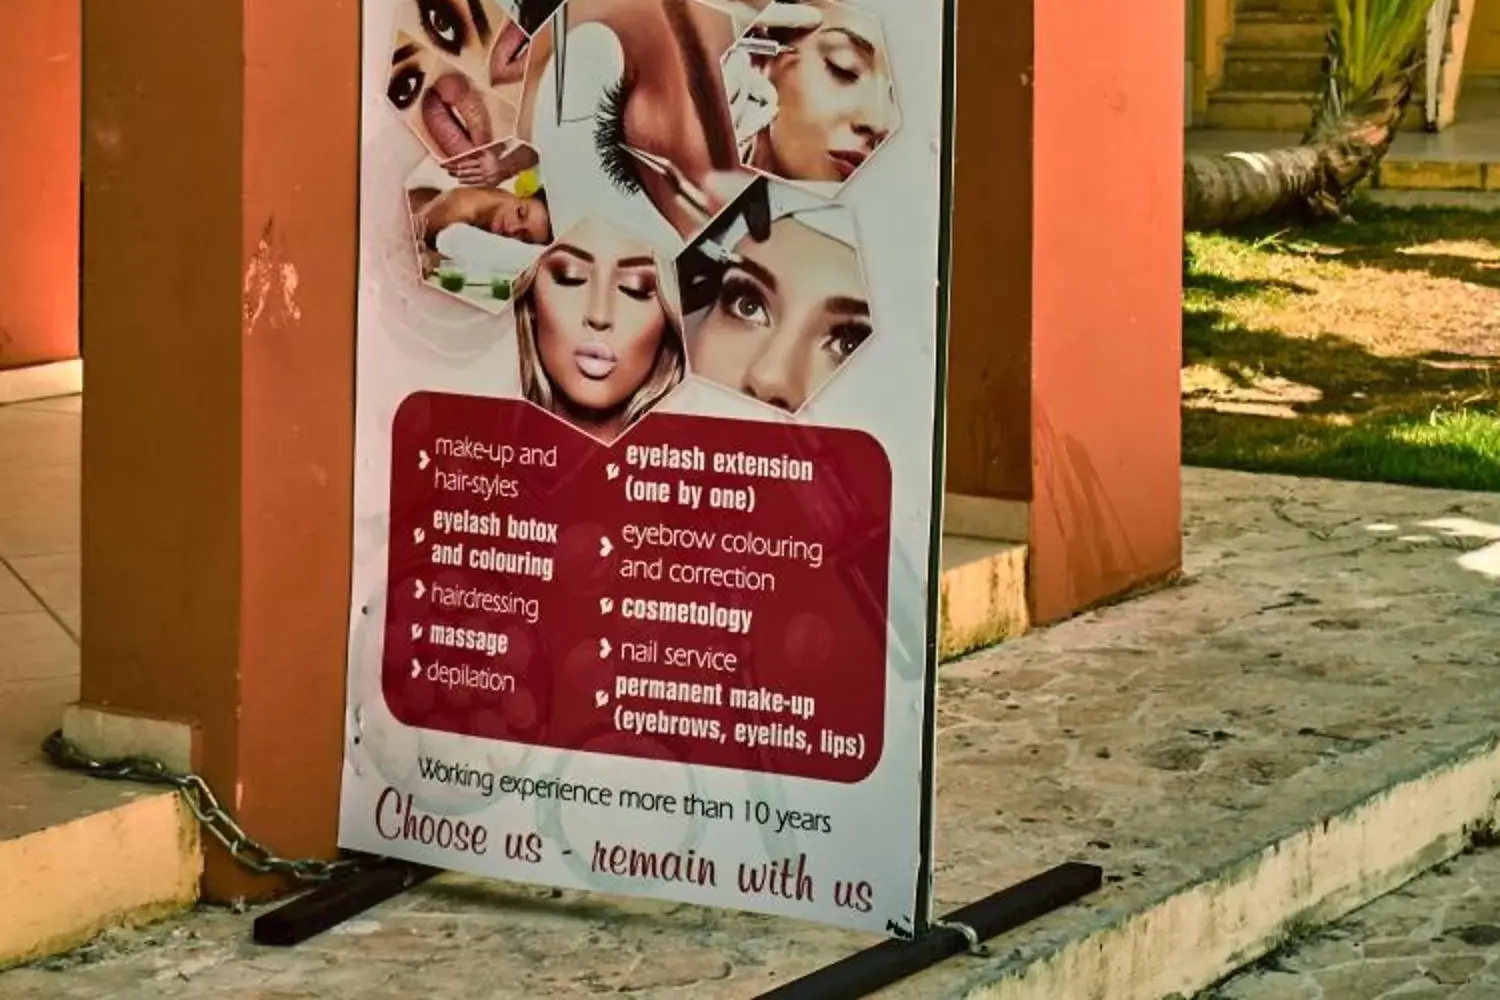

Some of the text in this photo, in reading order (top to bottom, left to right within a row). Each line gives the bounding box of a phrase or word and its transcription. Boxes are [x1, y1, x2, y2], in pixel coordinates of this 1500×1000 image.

[435, 435, 558, 467] make-up and
[626, 443, 814, 482] eyelash extension
[434, 469, 520, 500] hair-styles
[625, 480, 756, 513] (one by one)
[433, 508, 559, 545] eyelash botox
[622, 521, 823, 567] eyebrow colouring
[431, 541, 554, 581] and colouring
[620, 558, 776, 592] and correction
[431, 585, 540, 624] hairdressing
[622, 597, 753, 634] cosmetology
[430, 624, 508, 656] massage
[621, 638, 738, 673] nail service
[428, 659, 515, 694] depilation
[616, 674, 816, 719] permanent make-up
[613, 707, 866, 761] (eyebrows, eyelids, lips)
[418, 757, 832, 834] Working experience more than 10 years
[376, 786, 487, 855] Choose
[505, 834, 544, 864] us
[737, 852, 814, 902] with
[834, 878, 874, 913] us
